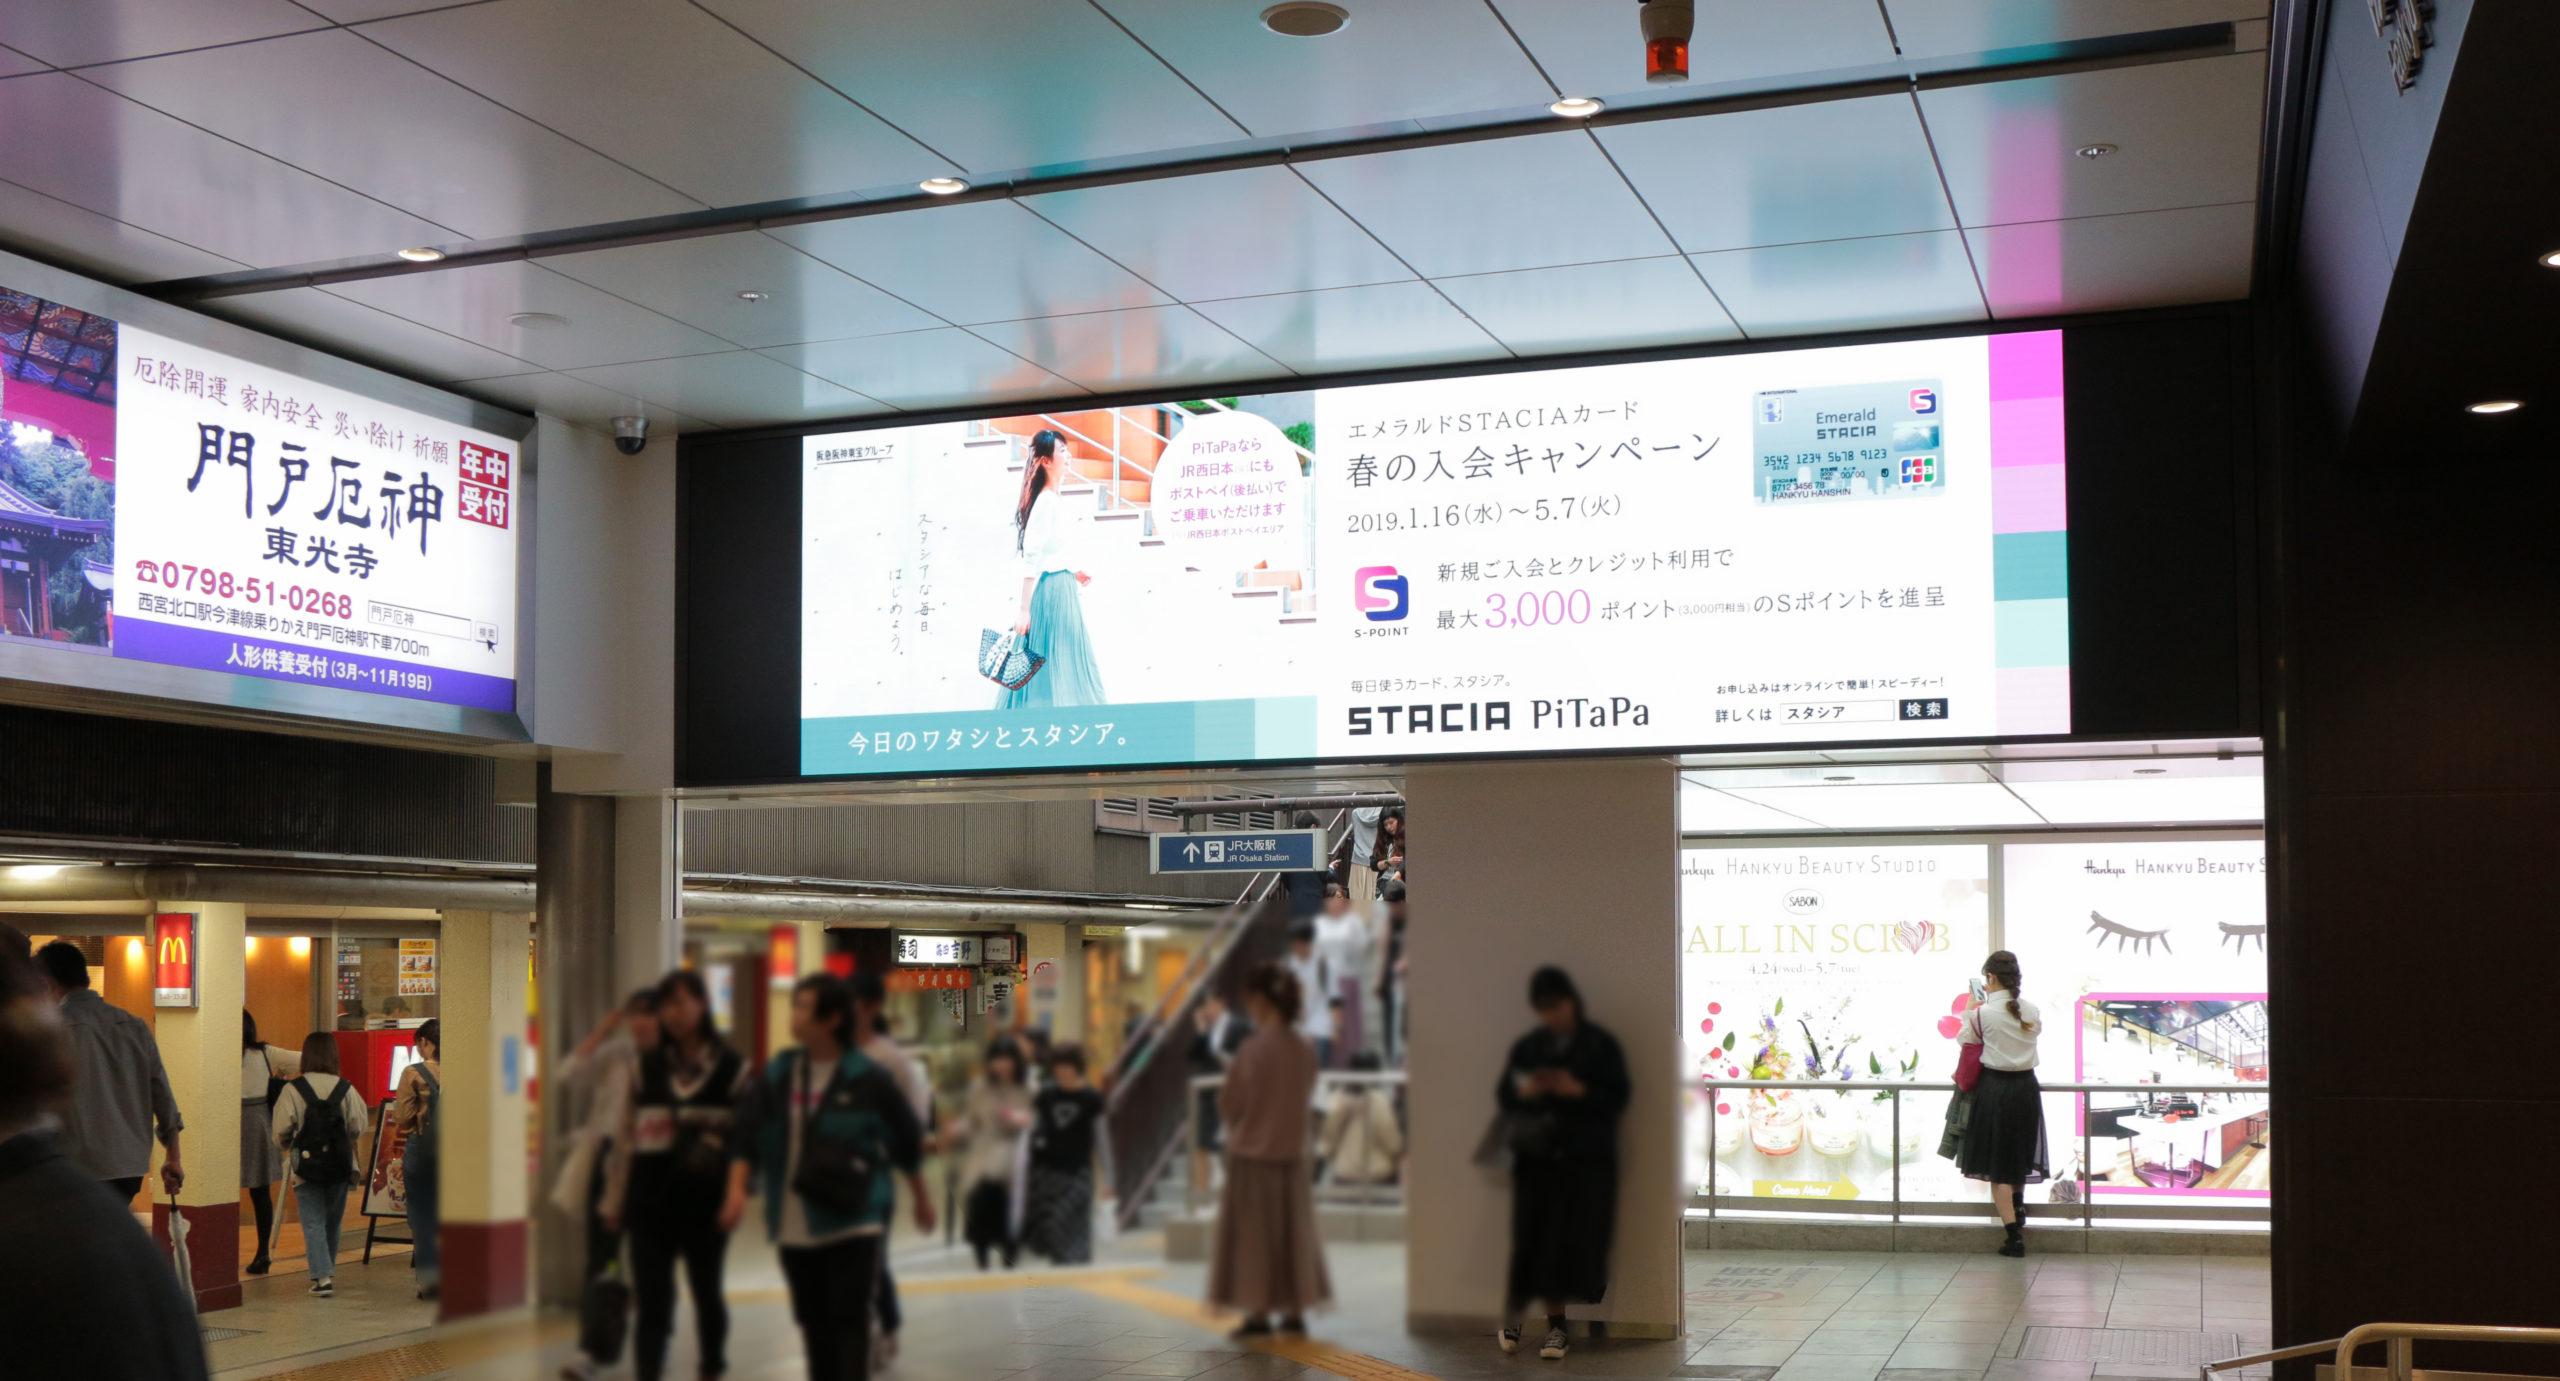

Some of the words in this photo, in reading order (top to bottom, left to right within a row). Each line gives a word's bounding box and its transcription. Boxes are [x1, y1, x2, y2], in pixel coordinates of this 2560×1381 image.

[134, 356, 228, 406] 厄除開運
[240, 384, 324, 431] 家内安全
[334, 411, 405, 453] 災い除け
[412, 433, 449, 466] 祈願
[1349, 401, 1638, 439] エメラルドSTACIAカード
[1816, 408, 1876, 424] Emerald
[1817, 425, 1877, 440] STACIA
[1192, 438, 1262, 455] PiTaPaなら
[1764, 456, 1789, 466] 3542
[1796, 453, 1821, 464] 1234
[1828, 450, 1854, 462] 5678
[1860, 448, 1887, 460] 9123
[461, 444, 507, 485] 年中
[1346, 434, 1720, 488] 春の入会キャンペーン
[187, 422, 444, 558] 門戸厄神
[1772, 490, 1810, 500] HANKYU
[1811, 488, 1850, 499] HANSHIN
[461, 484, 507, 526] 受付
[1170, 502, 1286, 523] ご乗車いただけます
[262, 526, 379, 579] 東光寺
[1437, 549, 1734, 583] 新規ご入会とクレジット利用で
[162, 561, 352, 620] 0798-51-0268
[371, 605, 415, 628] 門戸厄神
[1354, 626, 1409, 638] S-POINT
[1351, 674, 1510, 694] 毎日使うカード、スタシア。
[1348, 701, 1510, 736] STACIA
[1530, 696, 1649, 730] PiTaPa
[1715, 708, 1772, 723] 詳しくは
[1787, 705, 1845, 720] スタシア
[1905, 702, 1942, 718] 検索
[848, 722, 1127, 756] 今日のワタシとスタシア。
[1227, 840, 1276, 851] JR大阪駅
[1726, 857, 1793, 875] HANKYU
[1799, 856, 1865, 875] BEAUTY
[1871, 855, 1936, 873] STUDIO
[2084, 859, 2126, 878] Hankyu
[2135, 858, 2193, 874] HANKYU
[2197, 857, 2255, 873] BEAUTY
[1774, 924, 1816, 953] IN
